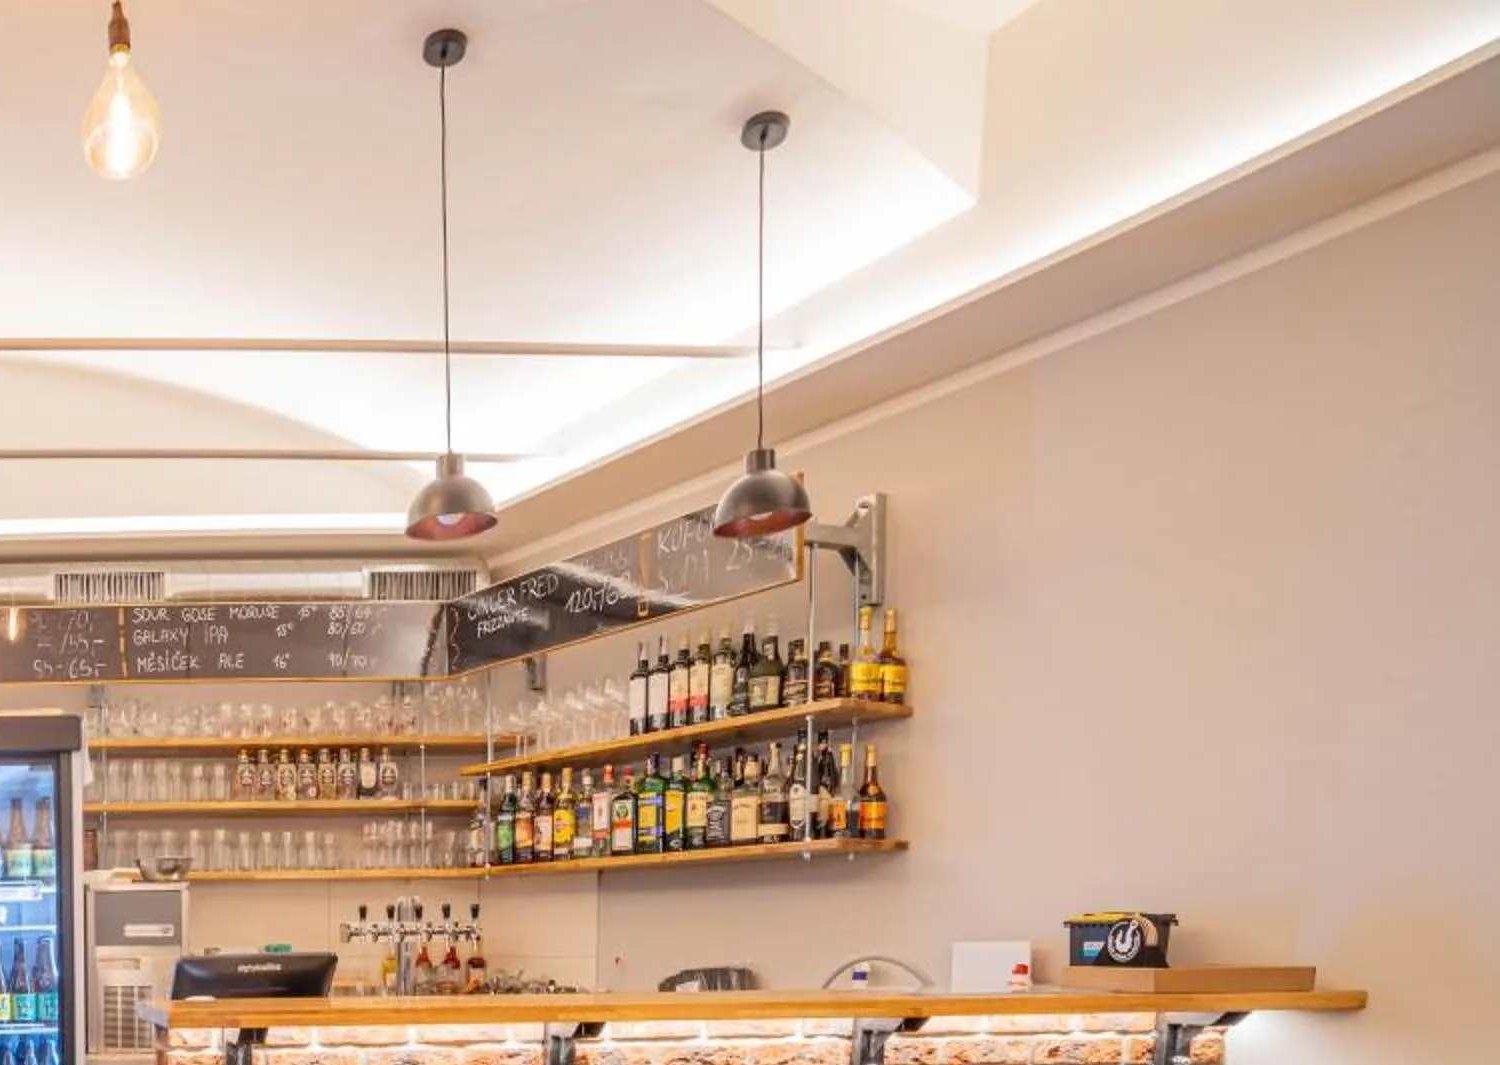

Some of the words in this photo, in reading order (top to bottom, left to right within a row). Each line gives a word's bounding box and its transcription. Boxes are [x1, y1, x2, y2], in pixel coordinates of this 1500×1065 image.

[520, 573, 559, 600] FRED
[131, 607, 171, 624] SOUR
[181, 606, 217, 623] GOSE
[132, 627, 189, 647] GALAXY
[204, 622, 230, 645] IPA
[218, 652, 245, 670] ALE
